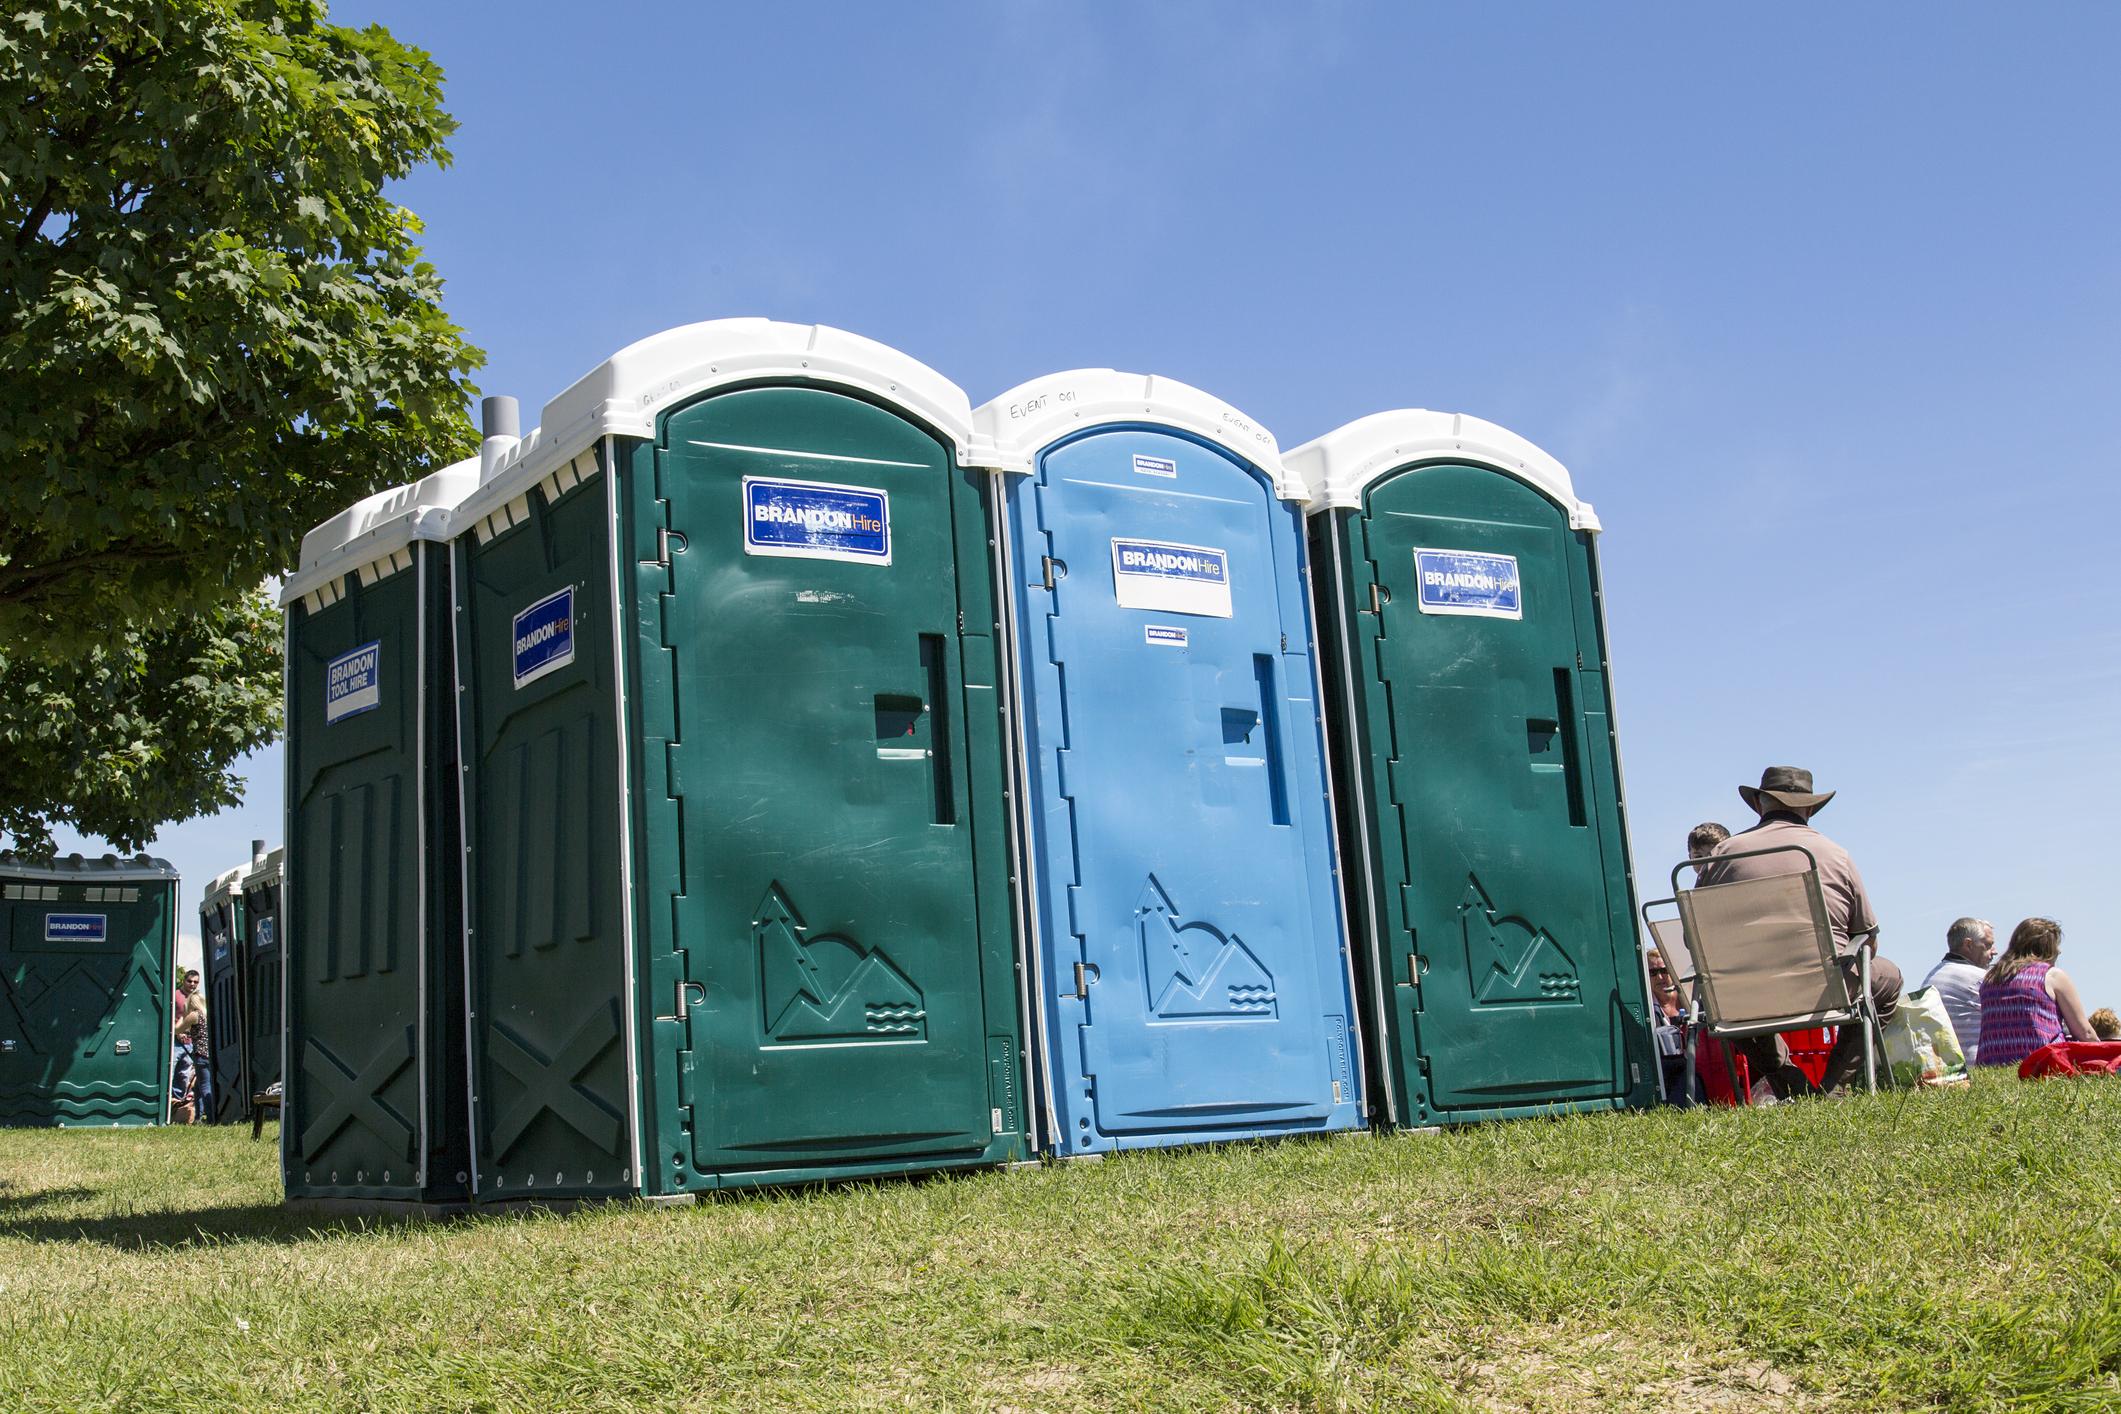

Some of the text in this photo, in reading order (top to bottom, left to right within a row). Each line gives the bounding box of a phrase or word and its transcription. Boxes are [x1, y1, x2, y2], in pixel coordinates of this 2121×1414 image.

[1010, 394, 1048, 419] EVENT
[331, 652, 375, 686] BRANDON
[331, 672, 368, 700] TOOL HIRE
